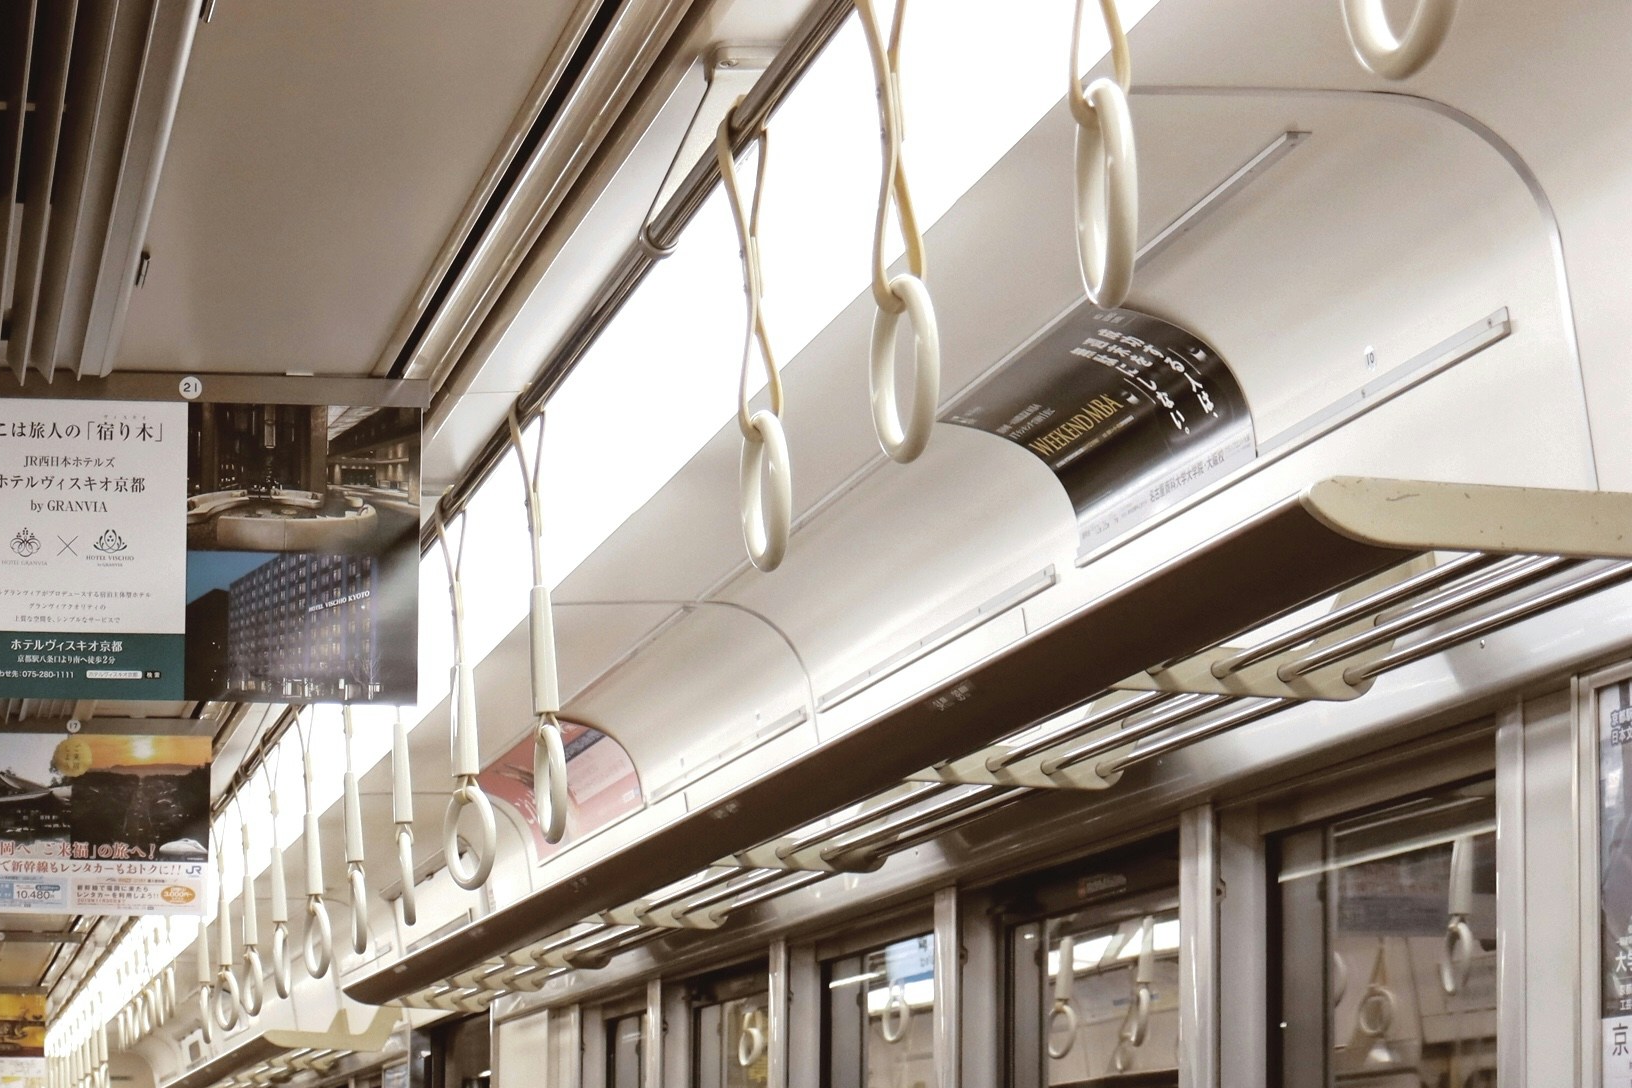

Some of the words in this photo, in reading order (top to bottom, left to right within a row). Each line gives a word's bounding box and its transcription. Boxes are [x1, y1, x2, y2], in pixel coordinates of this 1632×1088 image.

[183, 382, 198, 393] 21
[1029, 412, 1095, 457] WEEKEND
[1082, 393, 1125, 423] MBA
[23, 455, 116, 468] JR西日本ホテルズ
[30, 500, 44, 513] by
[47, 500, 108, 513] GRANVIA
[348, 590, 370, 602] KYOTO
[10, 638, 123, 653] ホテルヴィスキオ京都
[185, 865, 202, 875] JR
